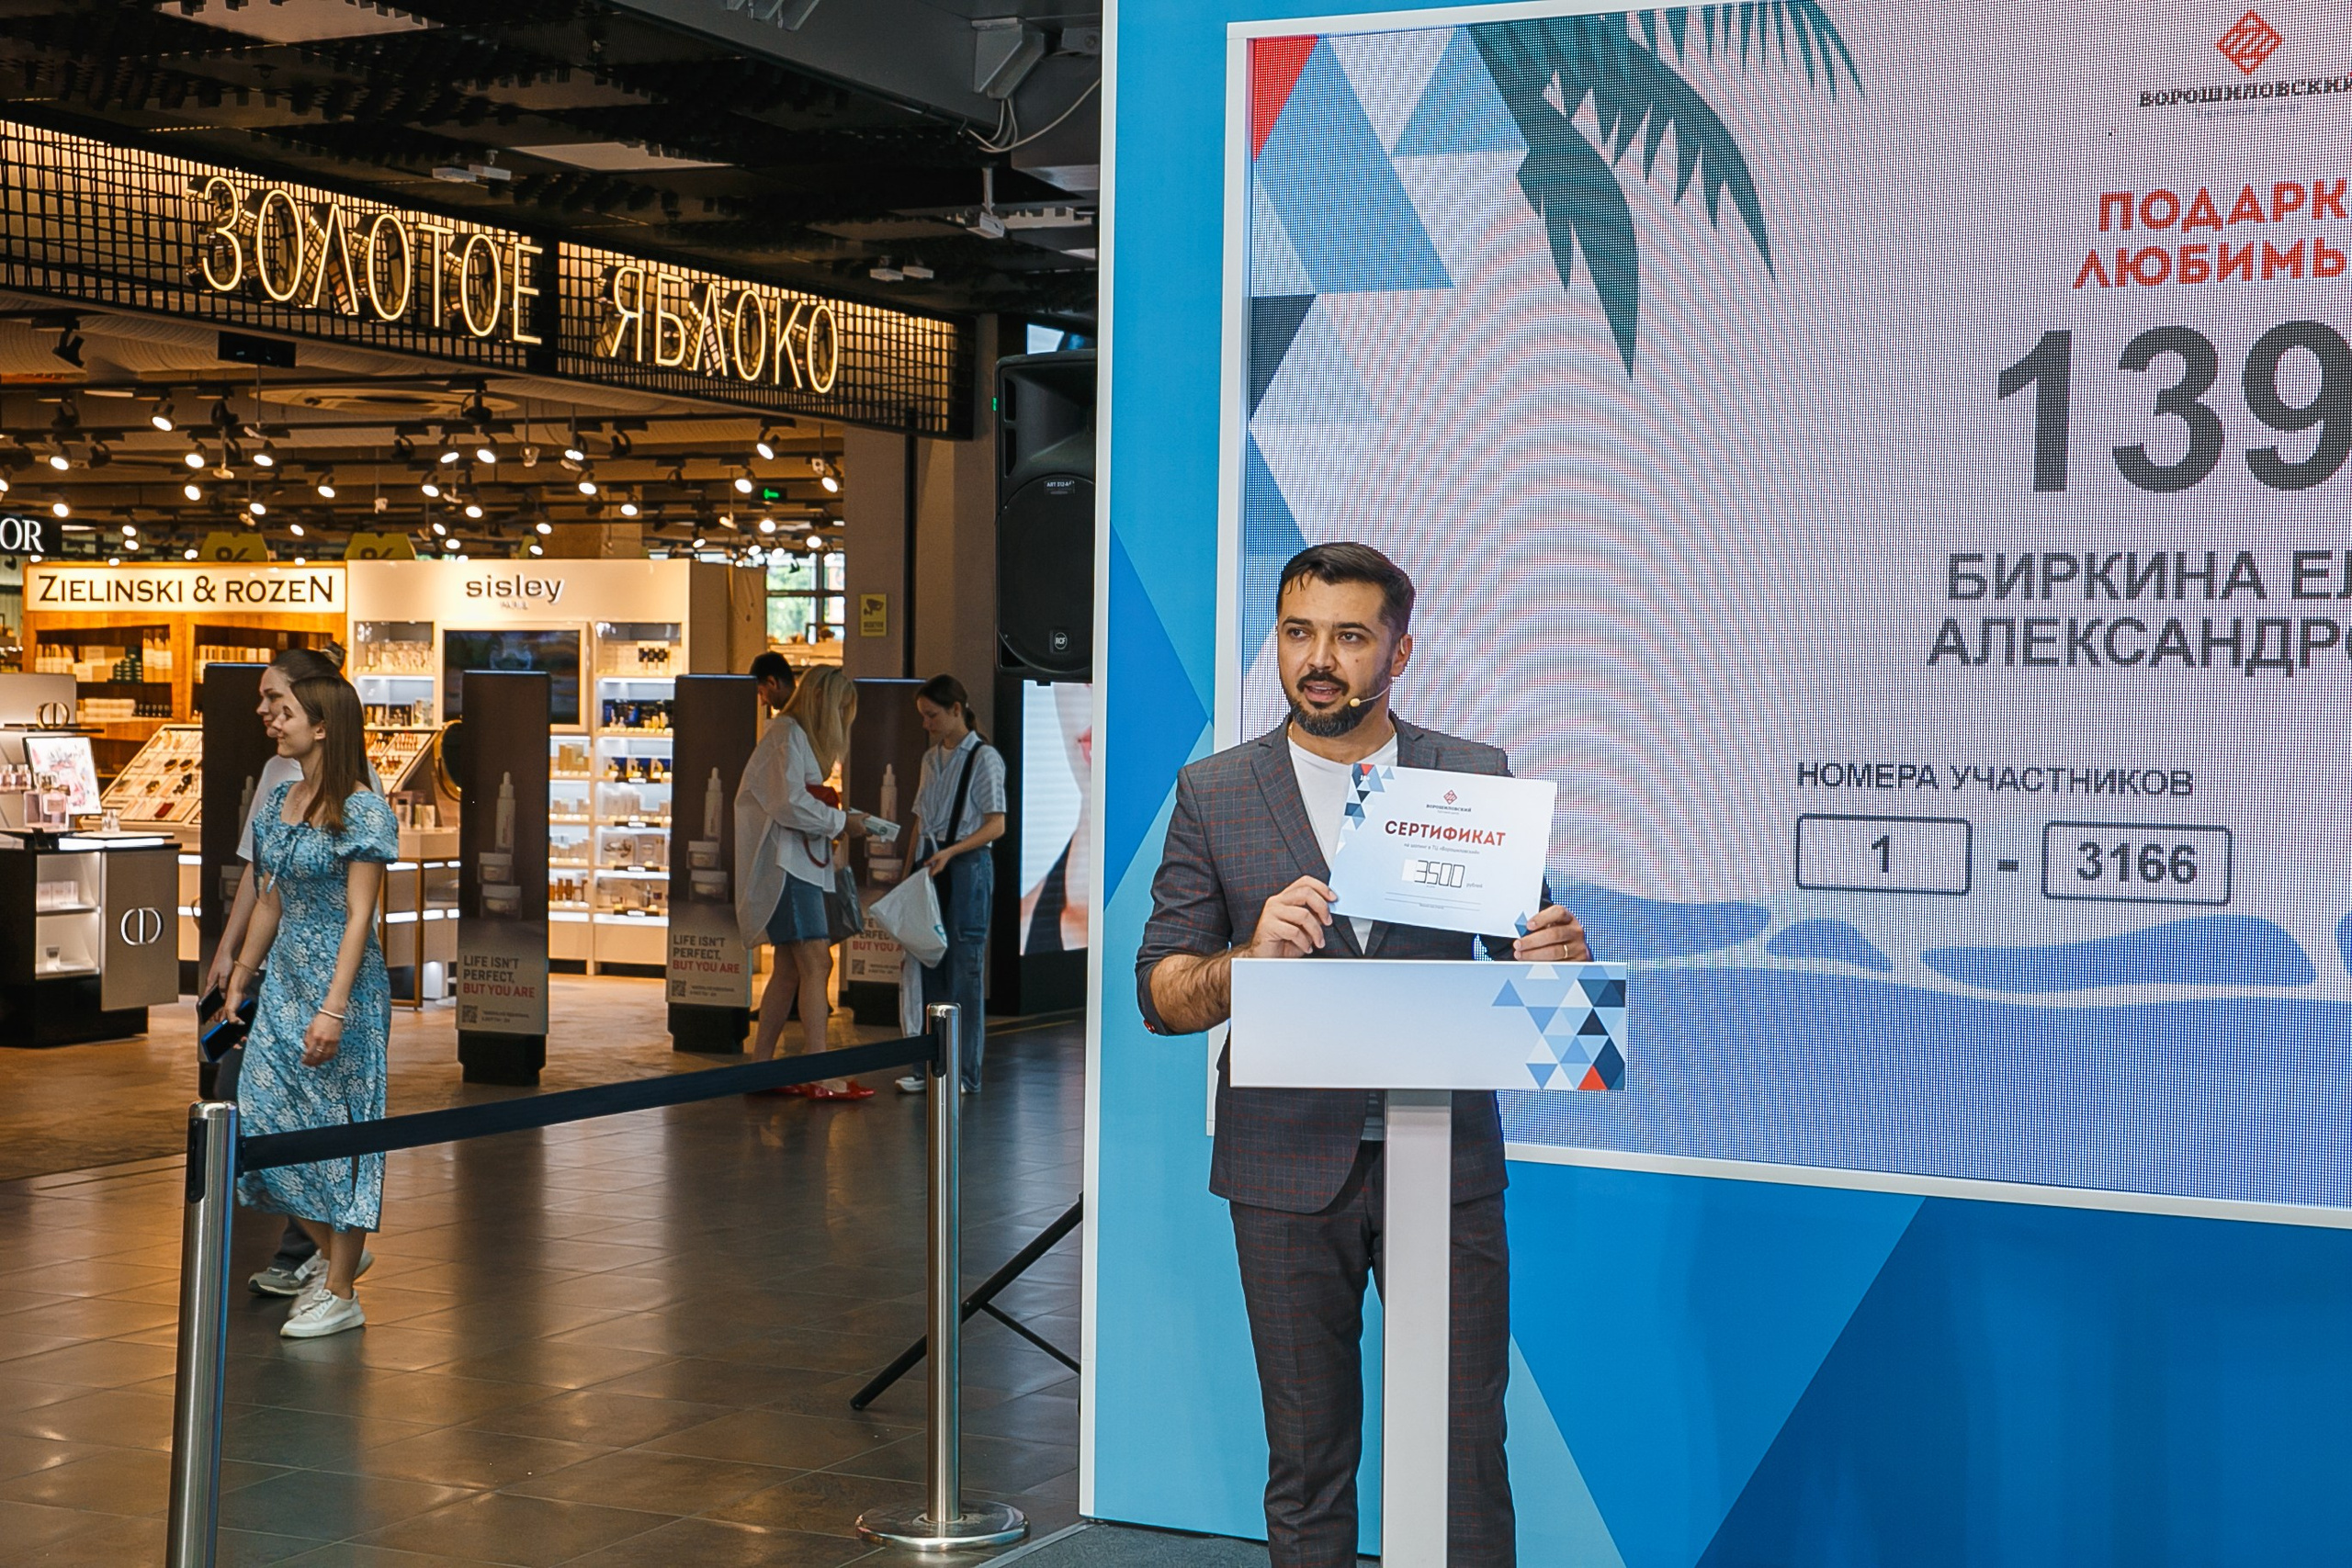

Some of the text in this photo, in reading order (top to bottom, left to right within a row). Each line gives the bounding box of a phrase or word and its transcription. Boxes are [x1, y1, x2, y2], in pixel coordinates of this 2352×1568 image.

[2099, 177, 2349, 233] ПОДАРК
[202, 176, 839, 393] ЗОЛОТОЕ ЯБЛОКО
[1997, 320, 2352, 492] 139
[38, 575, 333, 603] ZIELINSKI & ROZEN
[466, 574, 563, 604] sisley
[1949, 550, 2267, 600] БИРКИНА
[1927, 615, 2352, 678] АЛЕКСАНДР
[1797, 761, 2194, 796] НОМЕРА УЧАСТНИКОВ
[1385, 820, 1506, 846] СЕРТИФИКАТ
[1414, 859, 1465, 888] 3500
[1871, 833, 1890, 873] 1
[2076, 841, 2199, 885] 3166
[673, 934, 695, 946] LIFE
[853, 941, 872, 951] BUT
[463, 954, 488, 967] LIFE
[673, 959, 741, 974] BUT YOU ARE
[462, 982, 535, 998] BUT YOU ARE
